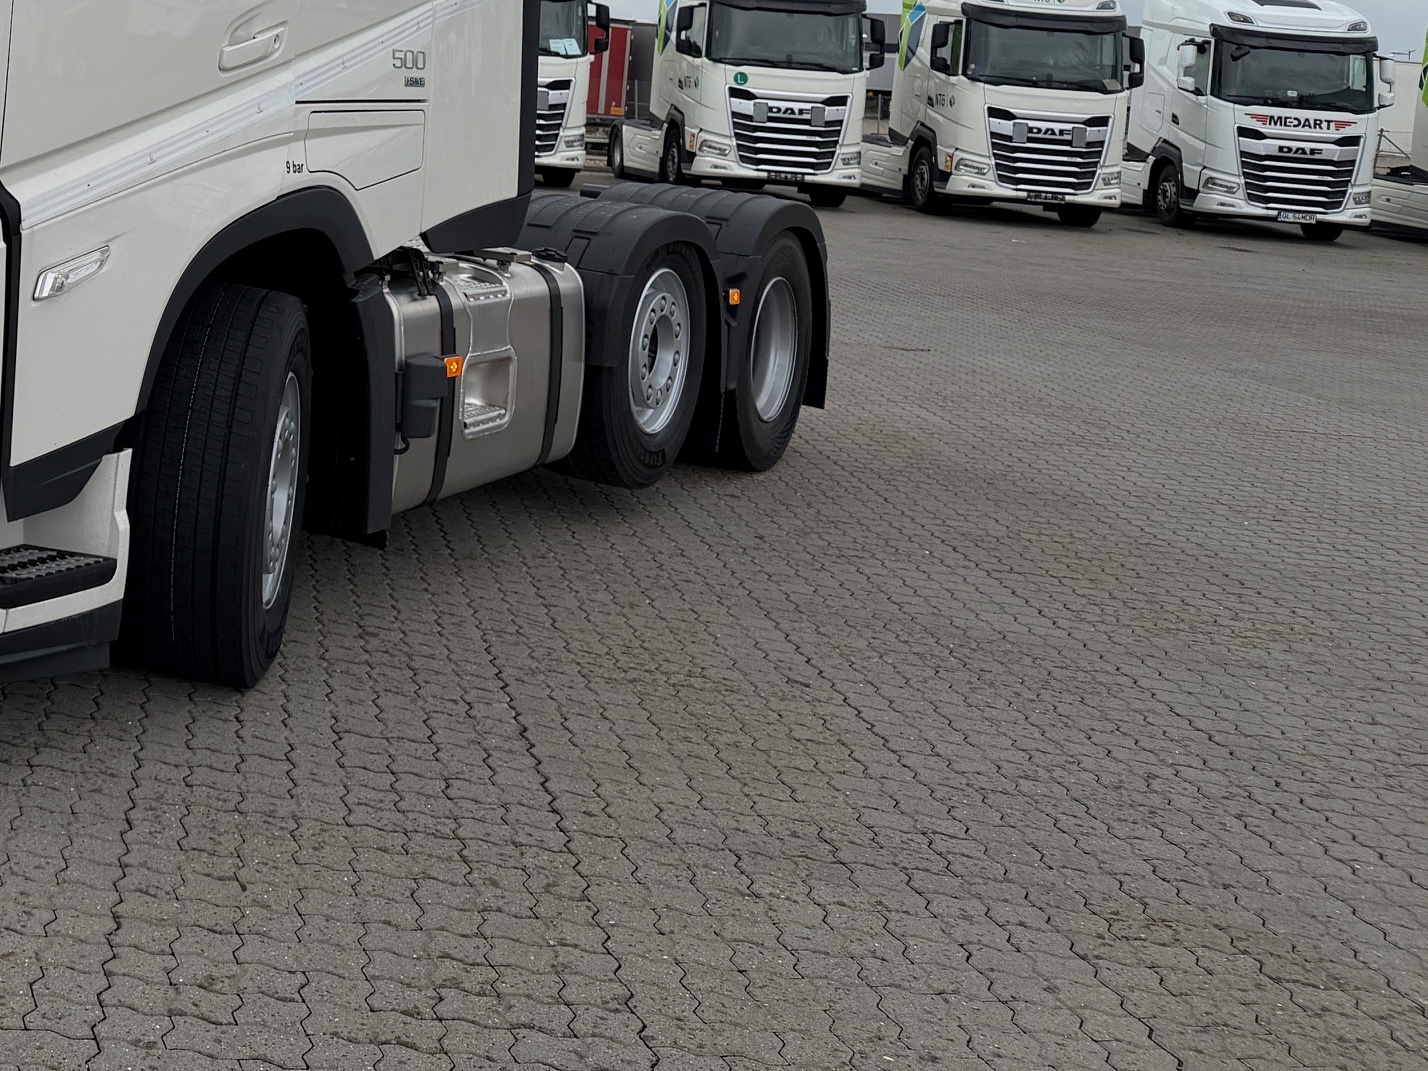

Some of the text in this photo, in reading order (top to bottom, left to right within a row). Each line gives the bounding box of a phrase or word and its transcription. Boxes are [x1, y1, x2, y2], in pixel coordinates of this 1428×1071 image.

[392, 49, 426, 70] 500
[767, 106, 811, 116] DAF
[1268, 115, 1334, 130] MEDART
[1028, 126, 1072, 137] DAF
[1278, 145, 1323, 156] DAF
[286, 161, 304, 174] 9 bar
